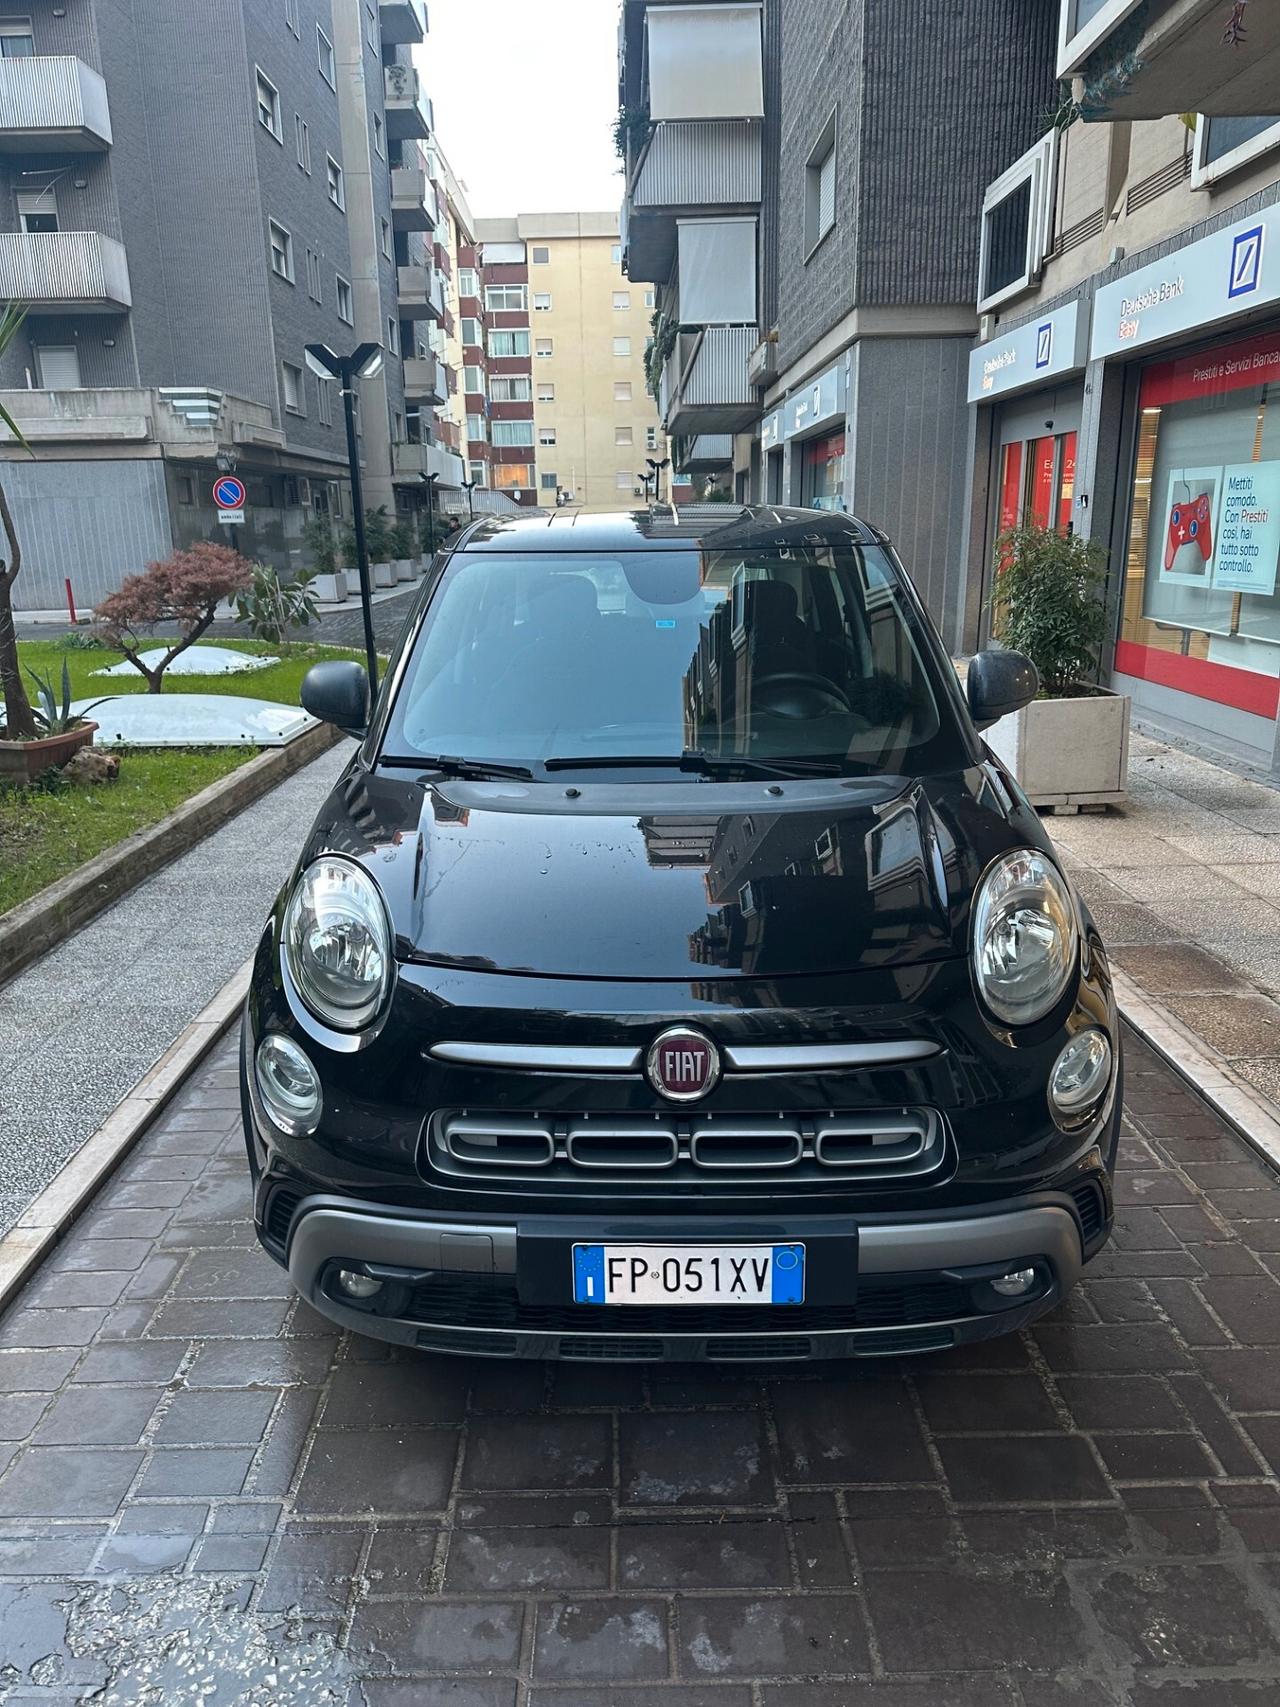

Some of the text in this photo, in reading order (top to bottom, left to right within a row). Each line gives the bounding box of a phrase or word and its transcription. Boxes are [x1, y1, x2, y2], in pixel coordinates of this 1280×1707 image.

[1120, 275, 1184, 318] Deutsche Bank
[1192, 351, 1280, 382] Prestiti e Servizi Banca
[1228, 476, 1254, 491] Mettiti
[1226, 492, 1258, 507] comodo.
[1224, 509, 1269, 524] Con Prestiti
[1240, 525, 1253, 540] hai
[1221, 544, 1260, 557] tutto sotto
[1219, 559, 1254, 573] controllo.
[664, 1051, 704, 1082] FIAT
